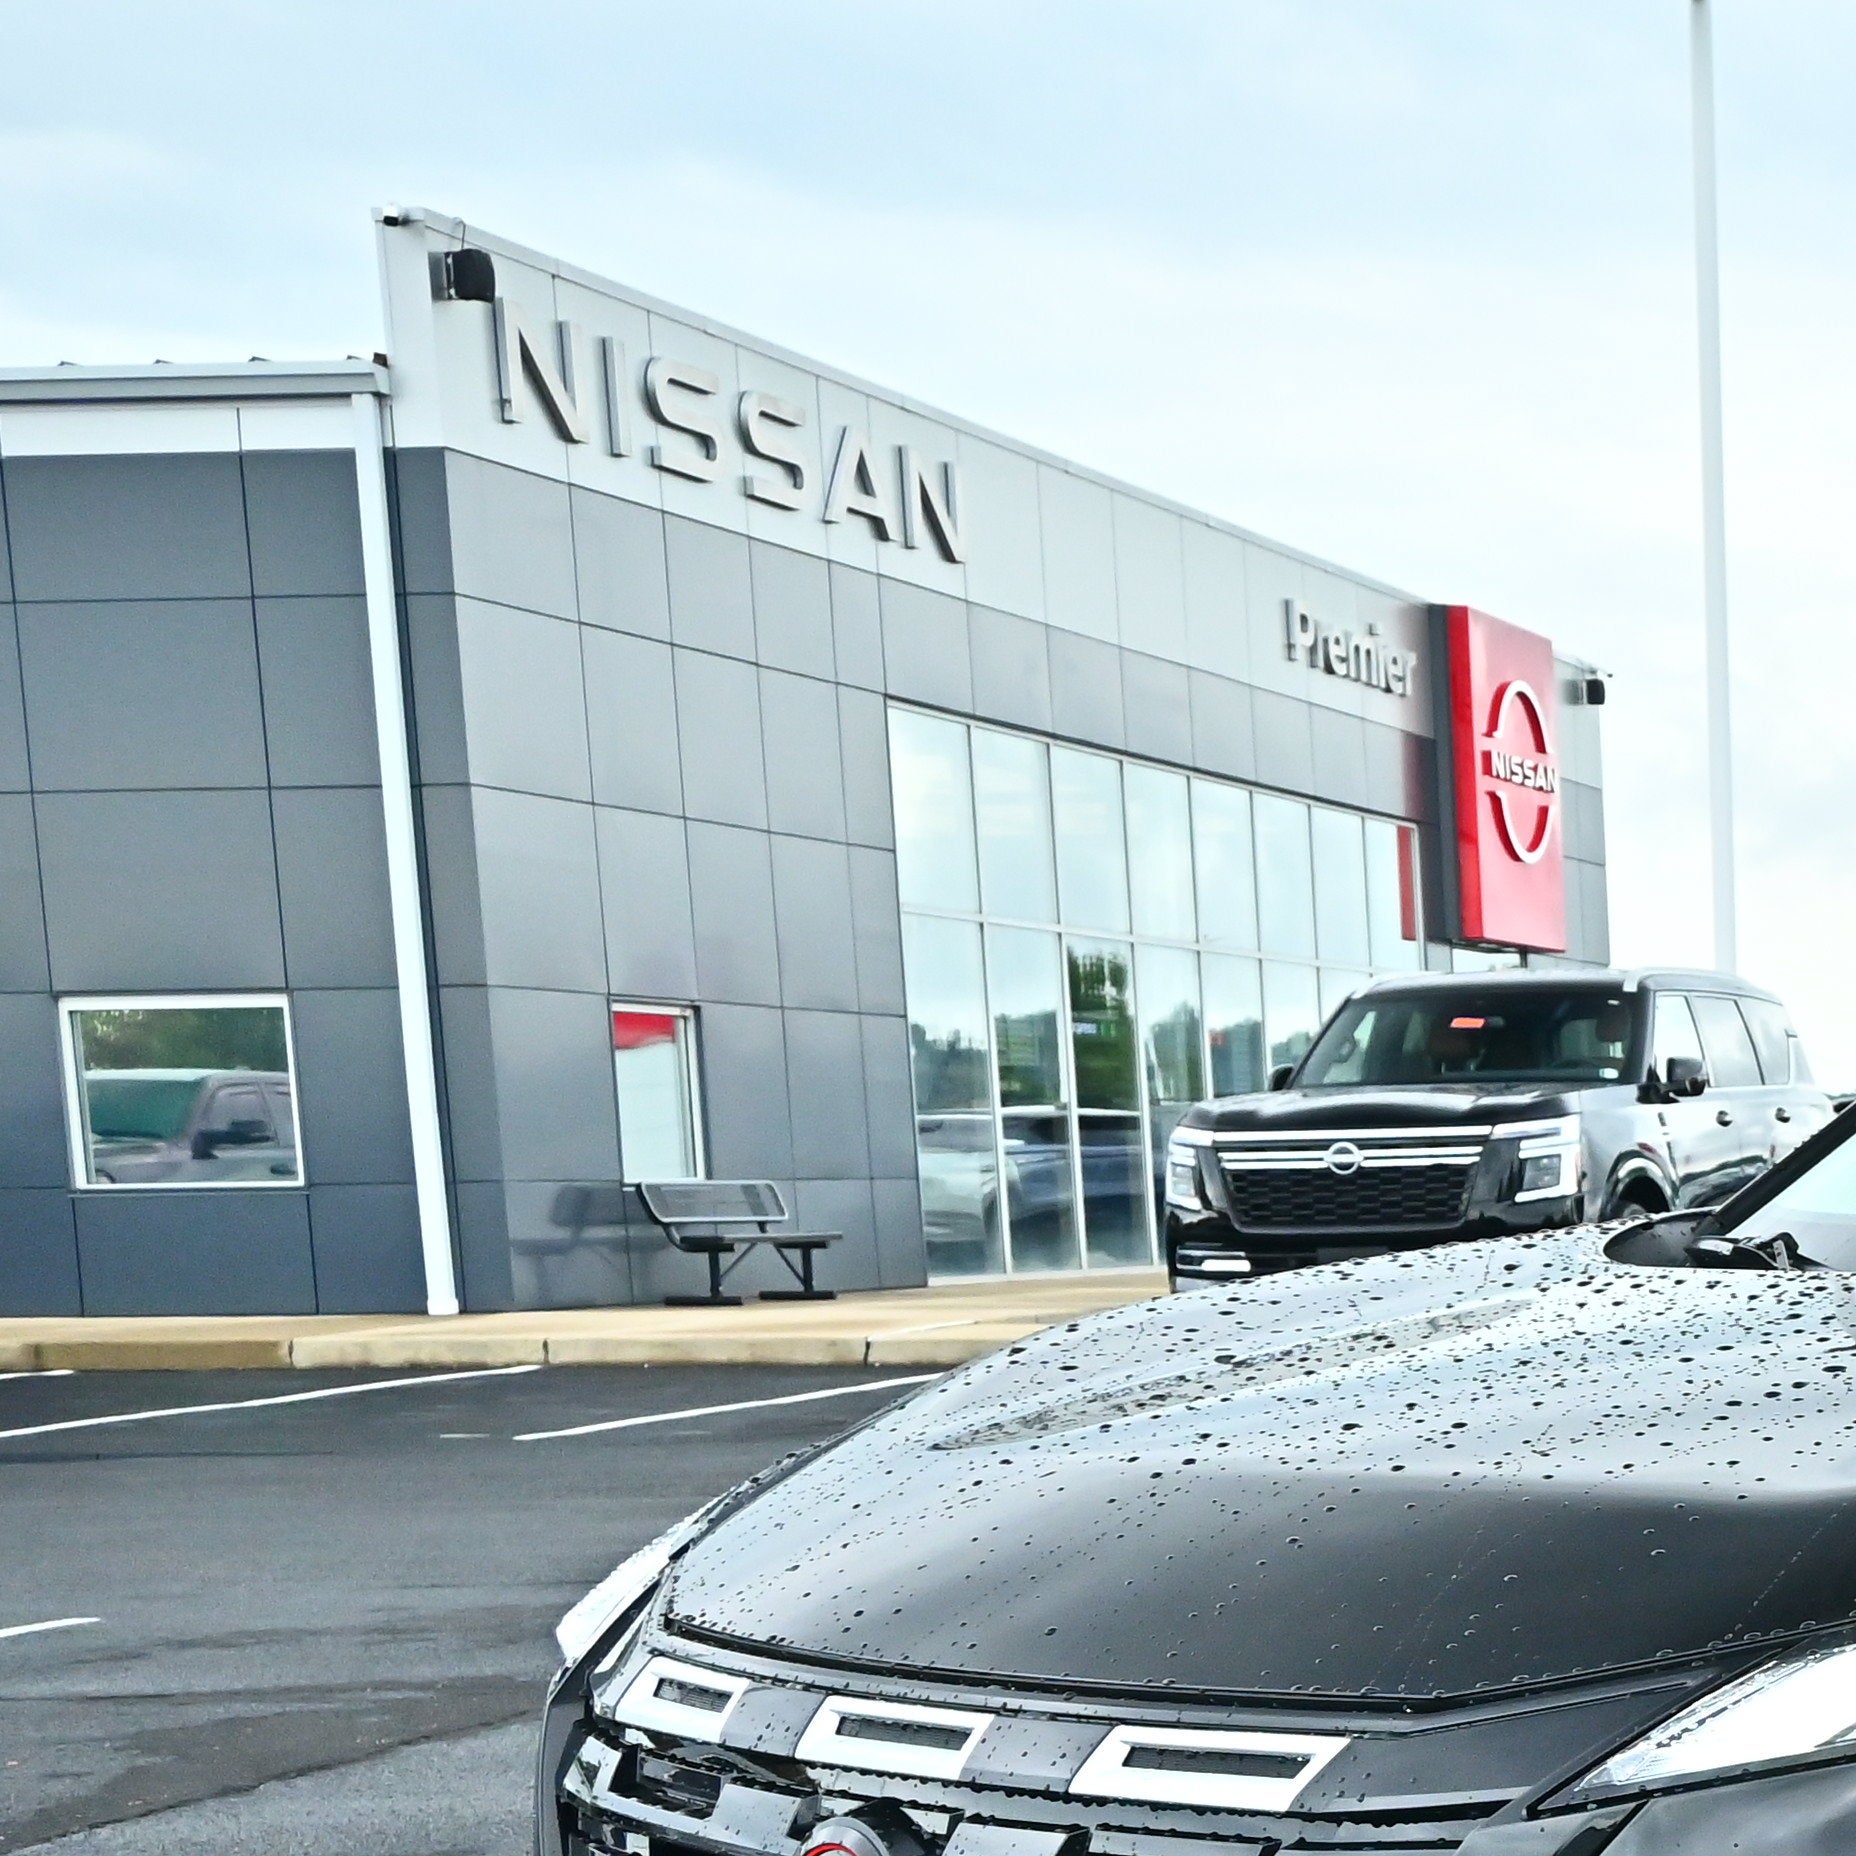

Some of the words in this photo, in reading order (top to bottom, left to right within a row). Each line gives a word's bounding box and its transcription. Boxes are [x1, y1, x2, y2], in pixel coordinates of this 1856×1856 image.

[495, 296, 967, 564] NISSAN
[1283, 598, 1416, 697] Premier
[1488, 749, 1560, 793] NISSAN
